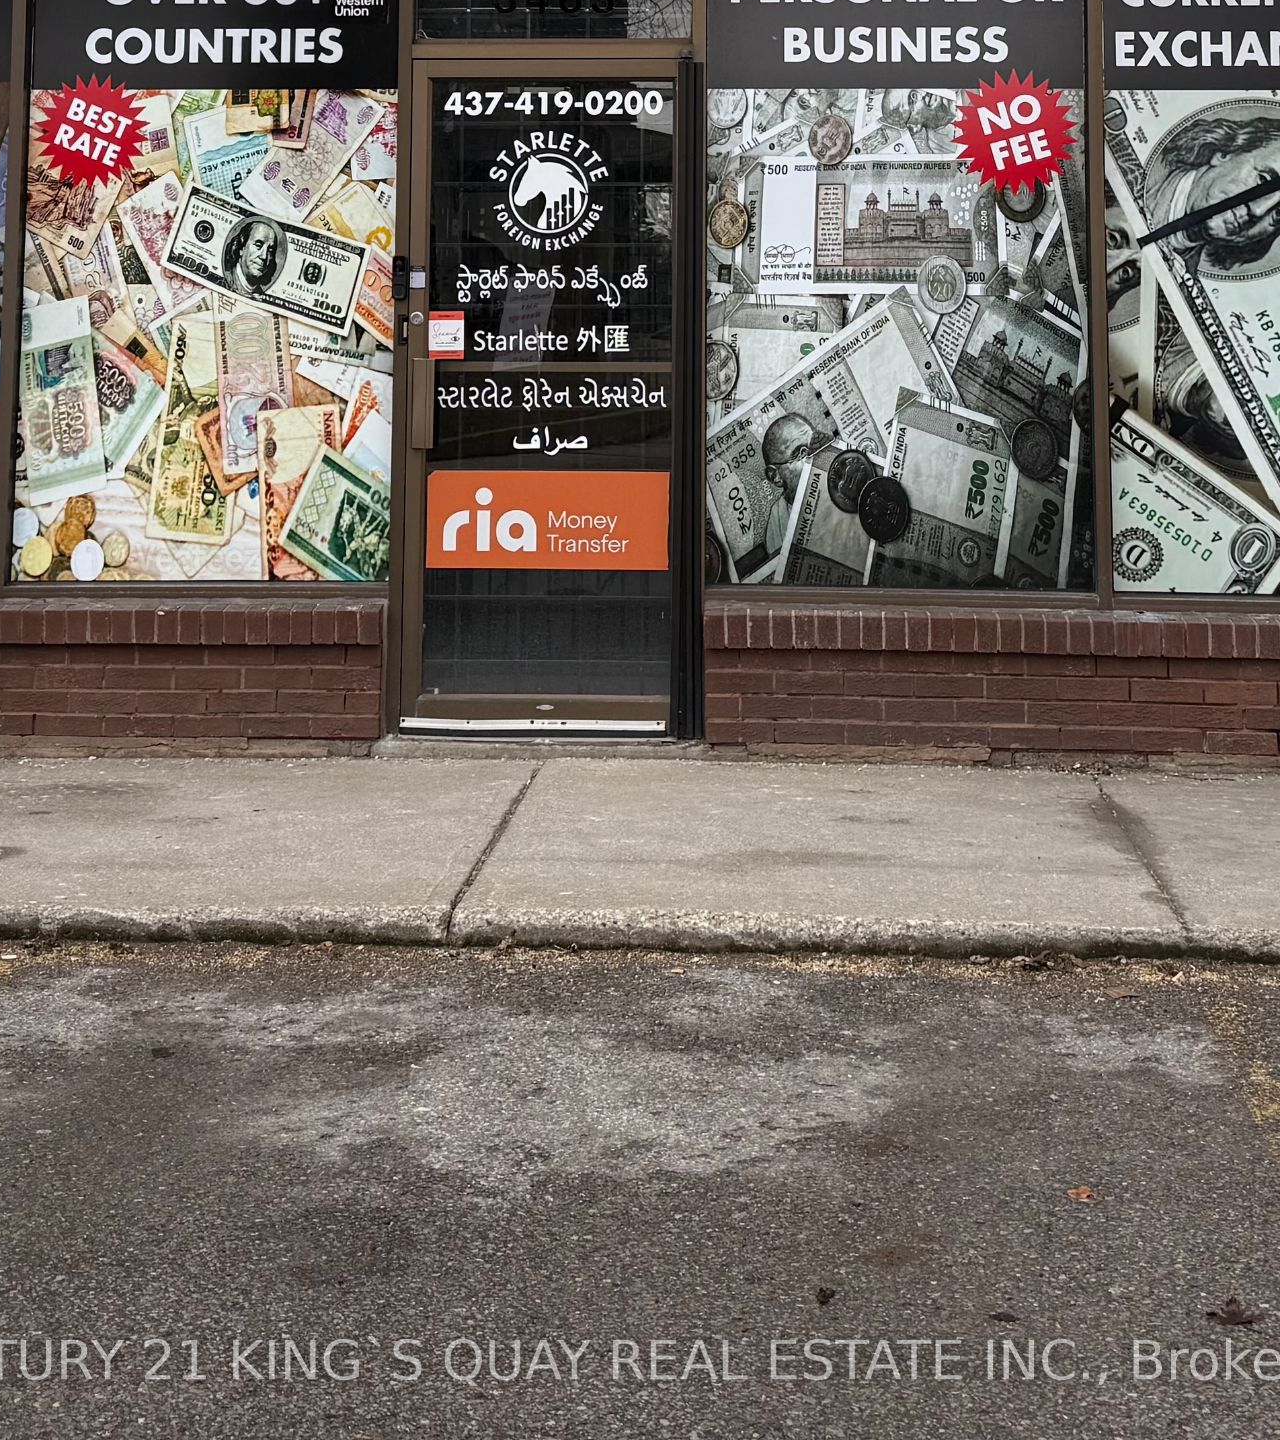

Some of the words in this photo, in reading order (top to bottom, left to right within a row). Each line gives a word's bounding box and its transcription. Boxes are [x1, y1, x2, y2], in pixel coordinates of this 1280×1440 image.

[334, 5, 370, 17] Union
[85, 27, 344, 64] COUNTRIES
[783, 26, 1009, 63] BUSINESS
[66, 97, 133, 139] BEST
[444, 90, 663, 116] 437-419-0200
[977, 94, 1041, 136] NO
[54, 123, 122, 168] RATE
[489, 130, 609, 183] STARLETTE
[989, 128, 1053, 172] FEE
[849, 163, 867, 171] INDIA
[872, 162, 888, 171] FIVE
[888, 162, 922, 170] HUNDRED
[923, 162, 952, 170] RUPEES
[67, 234, 85, 251] 500
[493, 203, 541, 251] FOREIGN
[545, 203, 604, 252] EXCHANGE
[312, 298, 343, 315] 100
[473, 328, 569, 352] Starlette
[576, 325, 631, 353] 外匯
[810, 350, 846, 378] RESERVE
[841, 336, 862, 354] BANK
[870, 315, 891, 334] INDIA
[512, 425, 588, 456] صراف
[895, 426, 908, 455] INDIA
[893, 454, 902, 470] OF
[964, 459, 990, 520] ₹500
[442, 487, 537, 552] ria
[547, 510, 619, 533] Money
[797, 517, 811, 547] BANK
[808, 471, 822, 500] INDIA
[547, 533, 630, 554] Transfer
[1028, 498, 1061, 558] ₹500
